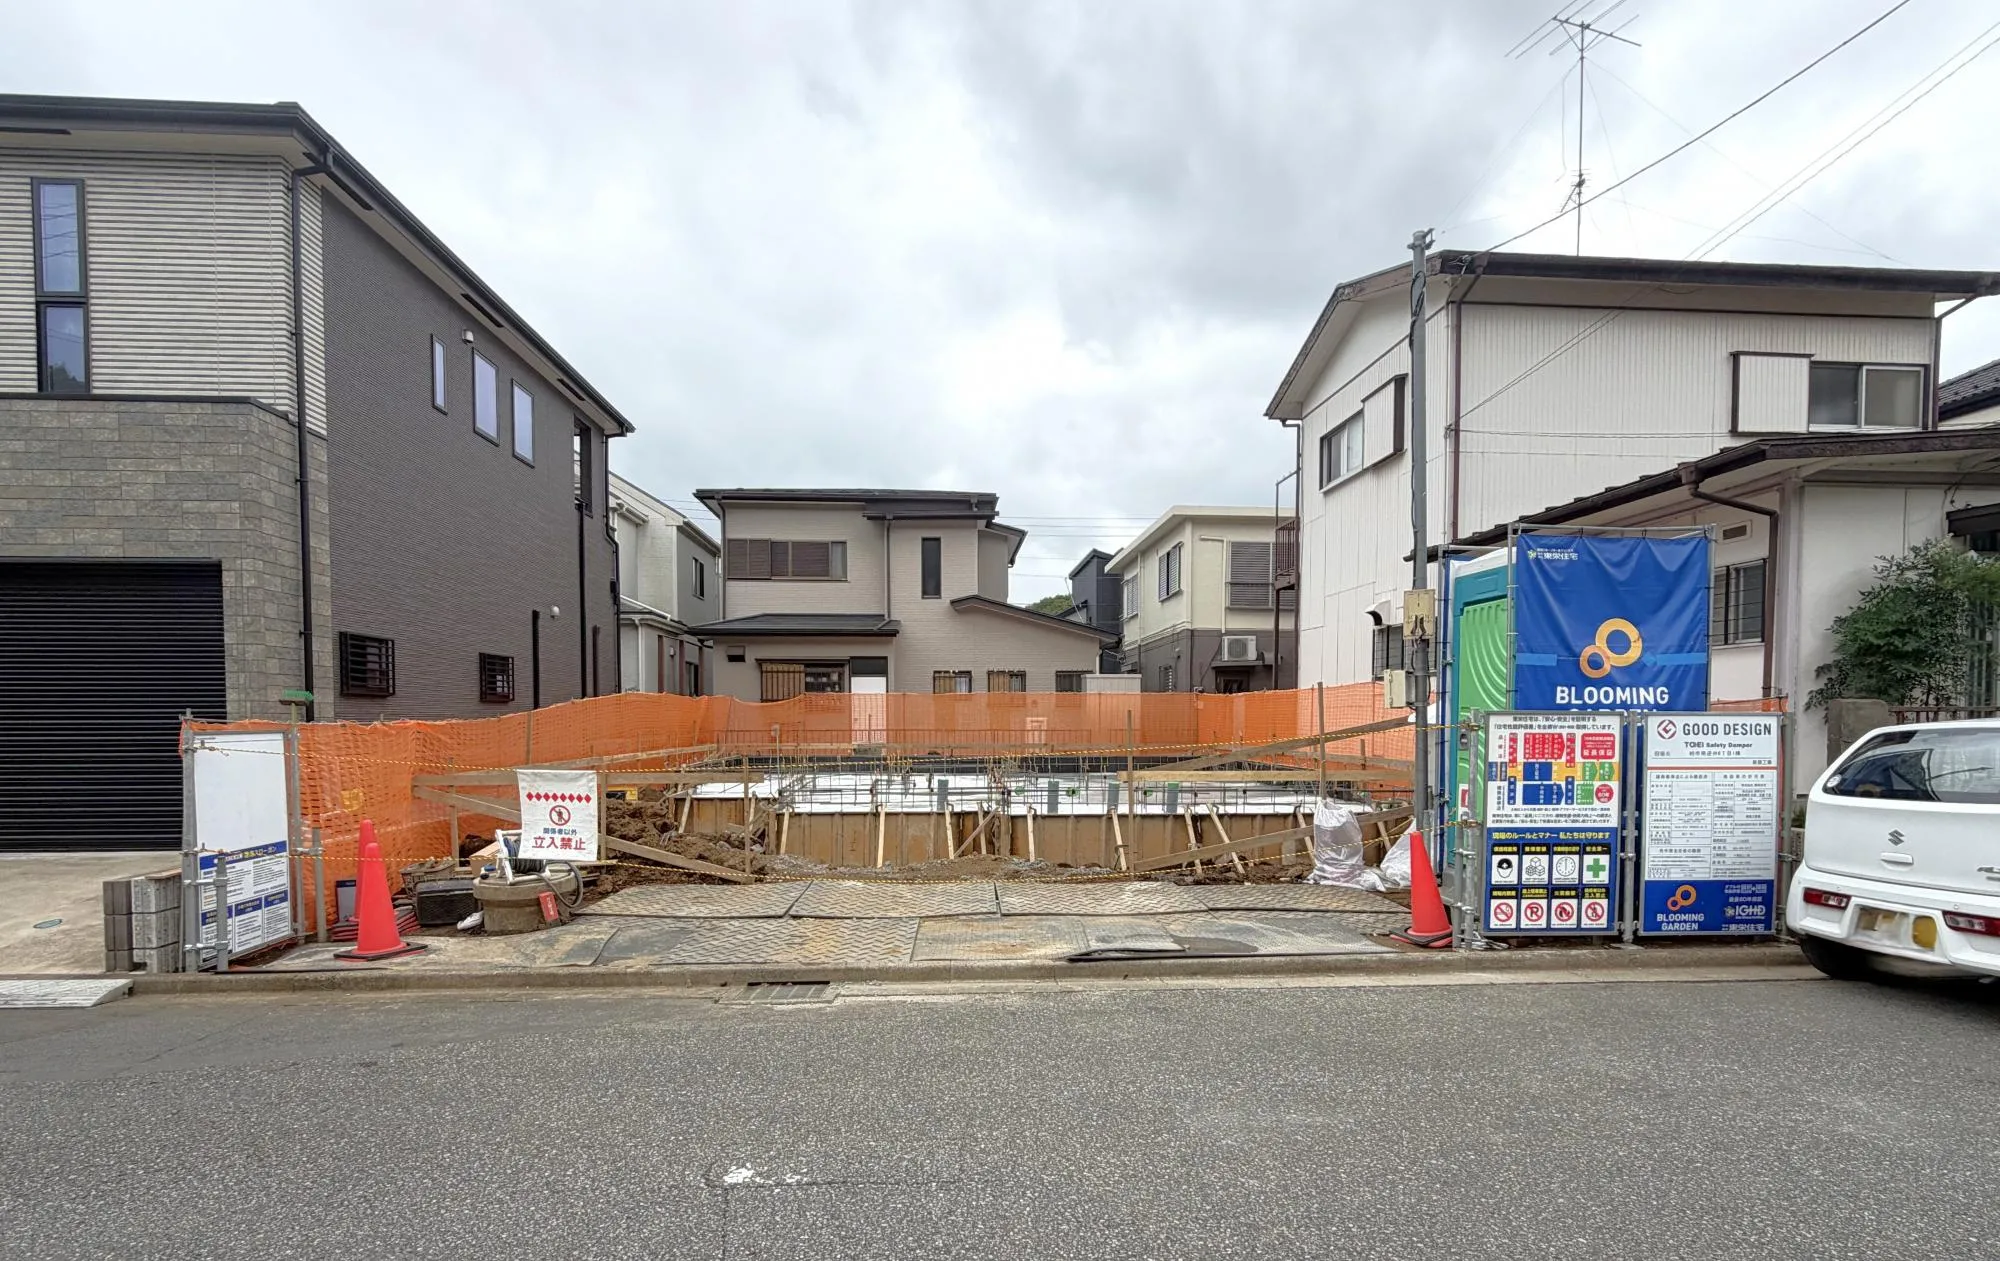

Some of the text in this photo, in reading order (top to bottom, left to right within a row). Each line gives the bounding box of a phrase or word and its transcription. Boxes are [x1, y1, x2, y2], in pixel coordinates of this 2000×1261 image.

[1556, 686, 1669, 705] BLOOMING
[1682, 723, 1772, 736] GOOD DESIGN
[1559, 832, 1611, 840] 私たちは守ります
[532, 835, 586, 850] 立入禁止
[1656, 913, 1705, 922] BLOOMING
[1661, 922, 1698, 931] GARDEN
